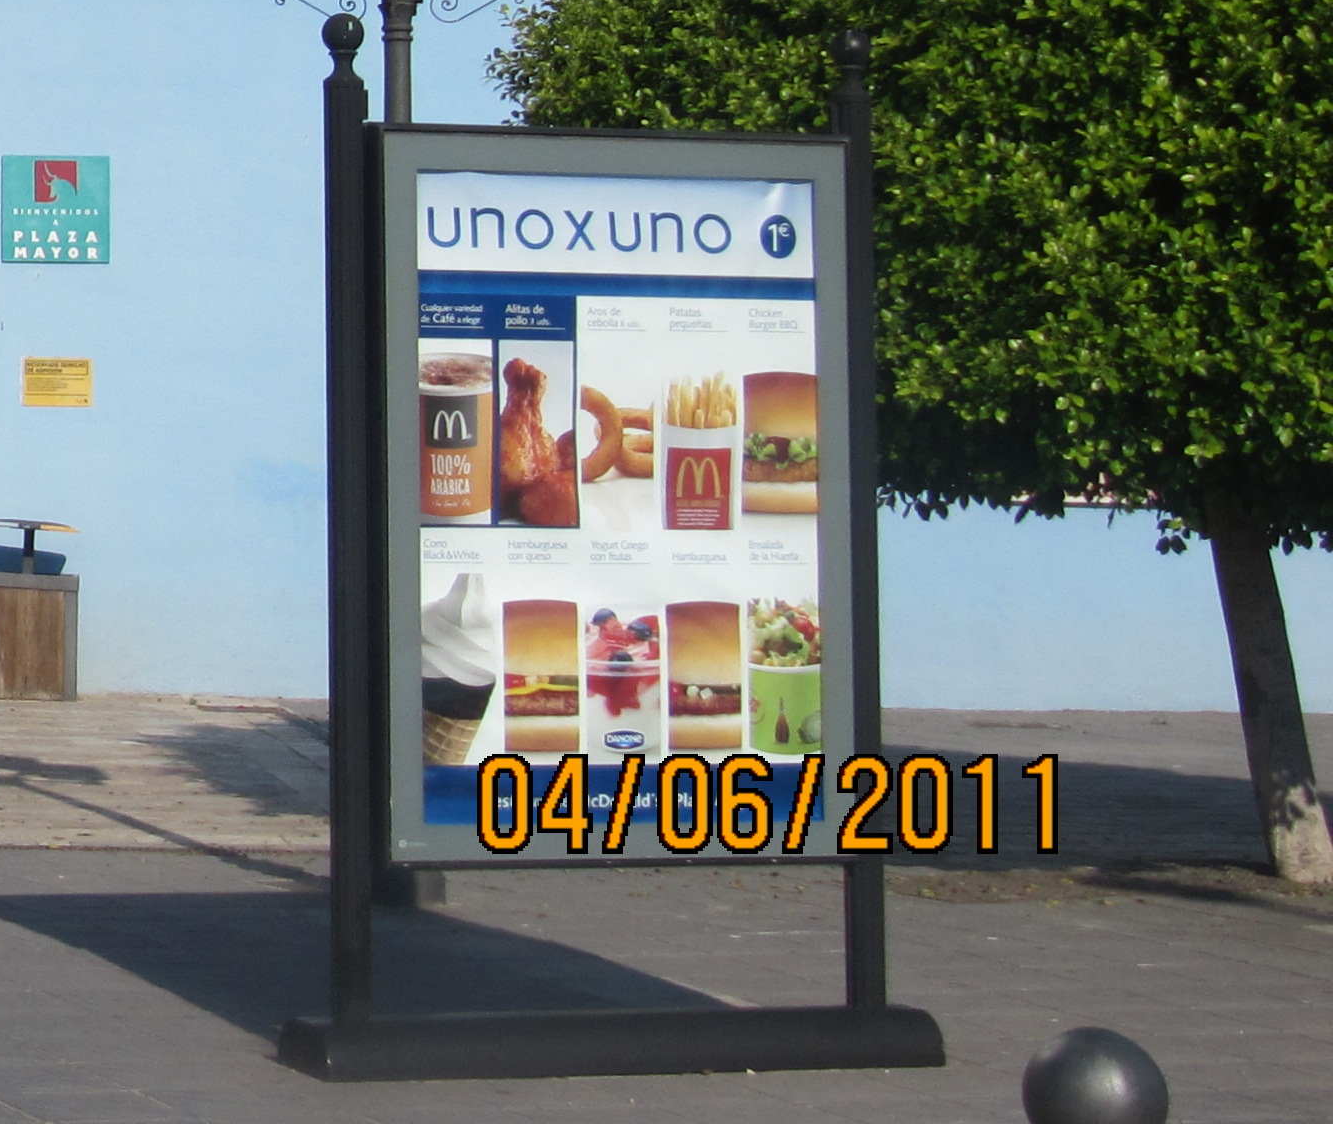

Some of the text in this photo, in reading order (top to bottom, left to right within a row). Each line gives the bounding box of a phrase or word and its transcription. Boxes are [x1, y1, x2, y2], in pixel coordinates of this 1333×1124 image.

[12, 207, 100, 216] BIENVENIDOS
[52, 218, 60, 226] A
[13, 230, 99, 244] PLAZA
[13, 246, 99, 260] MAYOR
[420, 303, 483, 314] Cualquier variedad
[505, 303, 545, 314] Alitas de
[587, 307, 621, 317] Aros de
[669, 307, 702, 318] Patatas
[748, 308, 783, 319] Chicken
[420, 315, 431, 323] de
[432, 313, 455, 324] Café
[505, 316, 528, 328] pollo
[587, 318, 618, 328] cebolla
[748, 320, 799, 332] Burger BBQ
[430, 454, 471, 475] 100%
[423, 538, 448, 549] Cono
[507, 540, 568, 551] Hamburguesa
[589, 540, 619, 551] Yogurt
[748, 540, 783, 550] Ensalada
[423, 549, 481, 561] Black&White
[507, 552, 552, 564] con queso
[589, 552, 632, 561] con frutas
[672, 552, 727, 564] Hamburguesa
[749, 552, 760, 561] de
